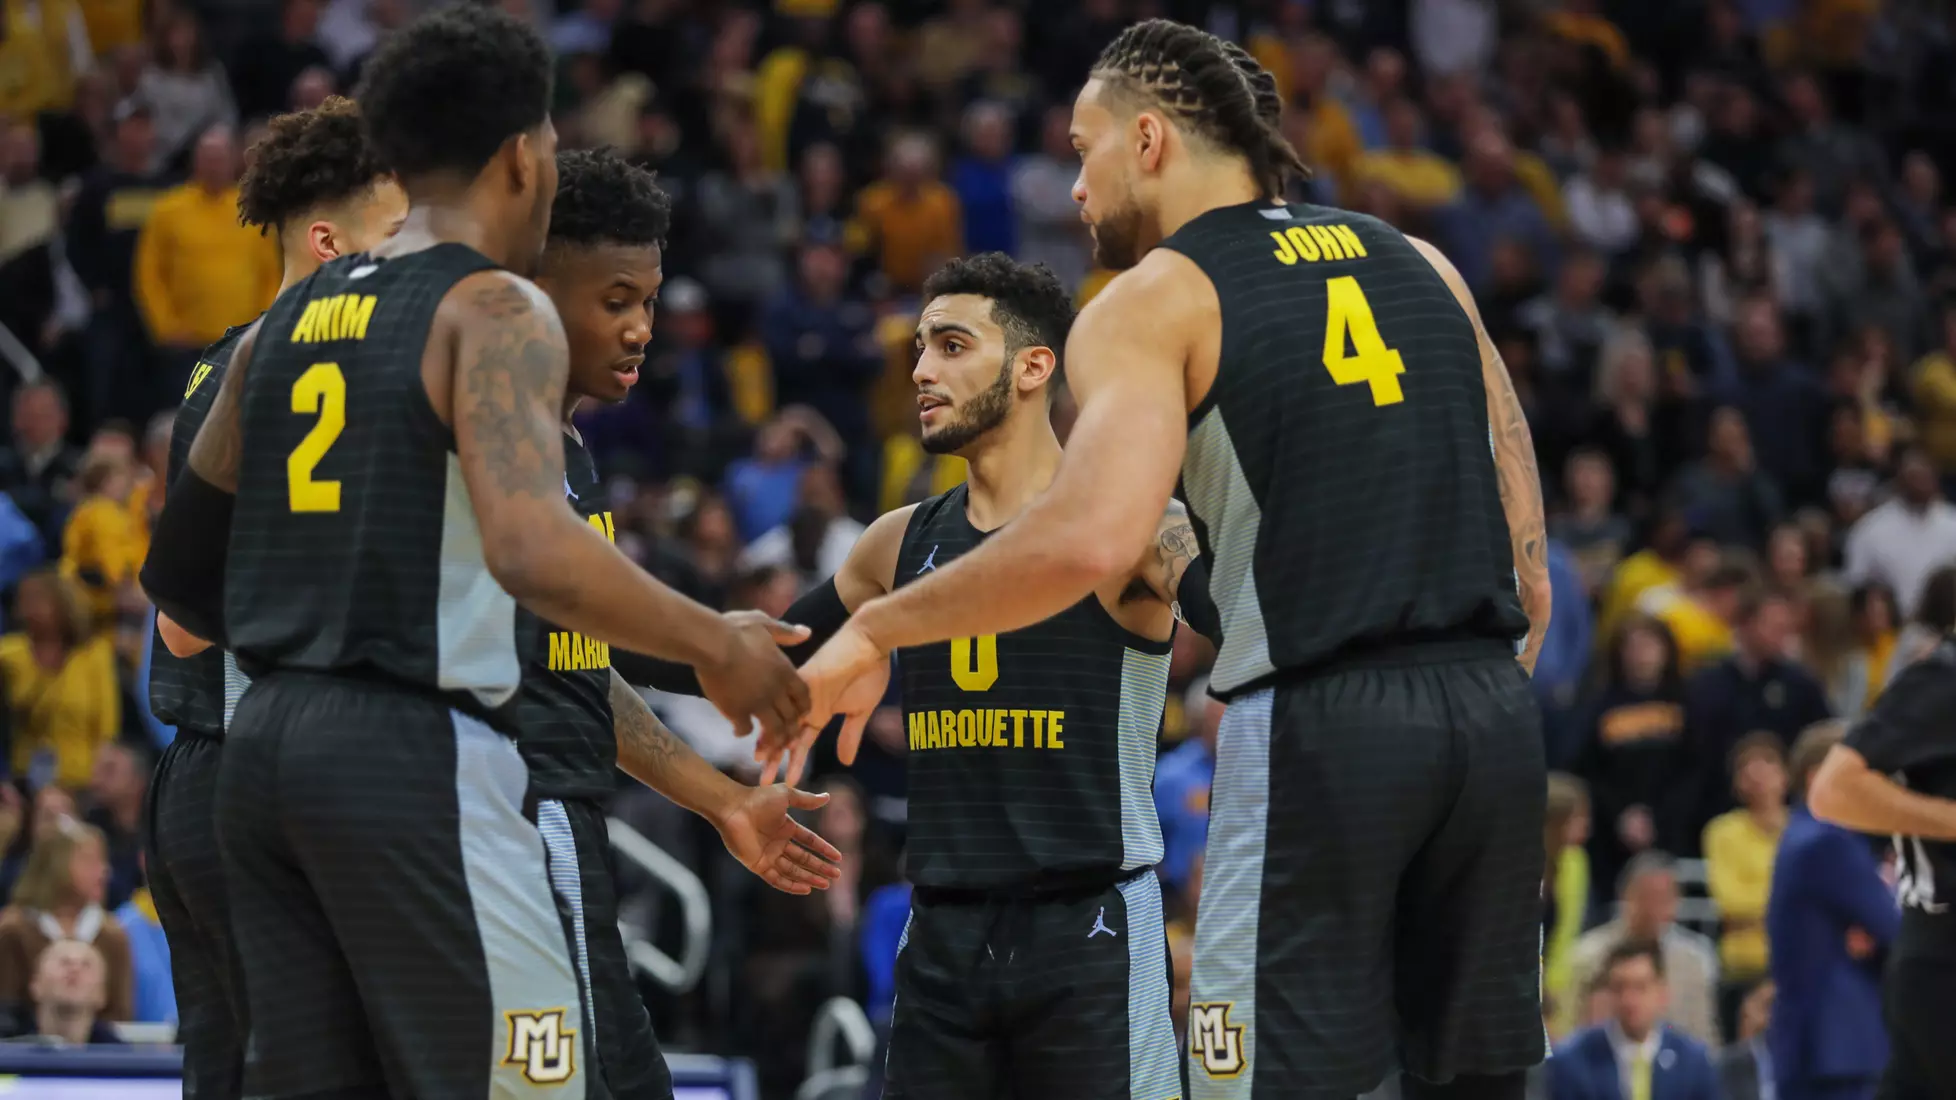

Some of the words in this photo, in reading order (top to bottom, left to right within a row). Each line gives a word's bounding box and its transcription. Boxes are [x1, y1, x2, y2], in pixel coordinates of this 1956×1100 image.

[1270, 224, 1367, 265] JOHN
[291, 294, 377, 343] ANIM
[1322, 275, 1406, 407] 4
[287, 362, 346, 512] 2
[909, 709, 1065, 750] MARQUETTE
[500, 1006, 577, 1087] MU
[1190, 1001, 1248, 1079] MU
